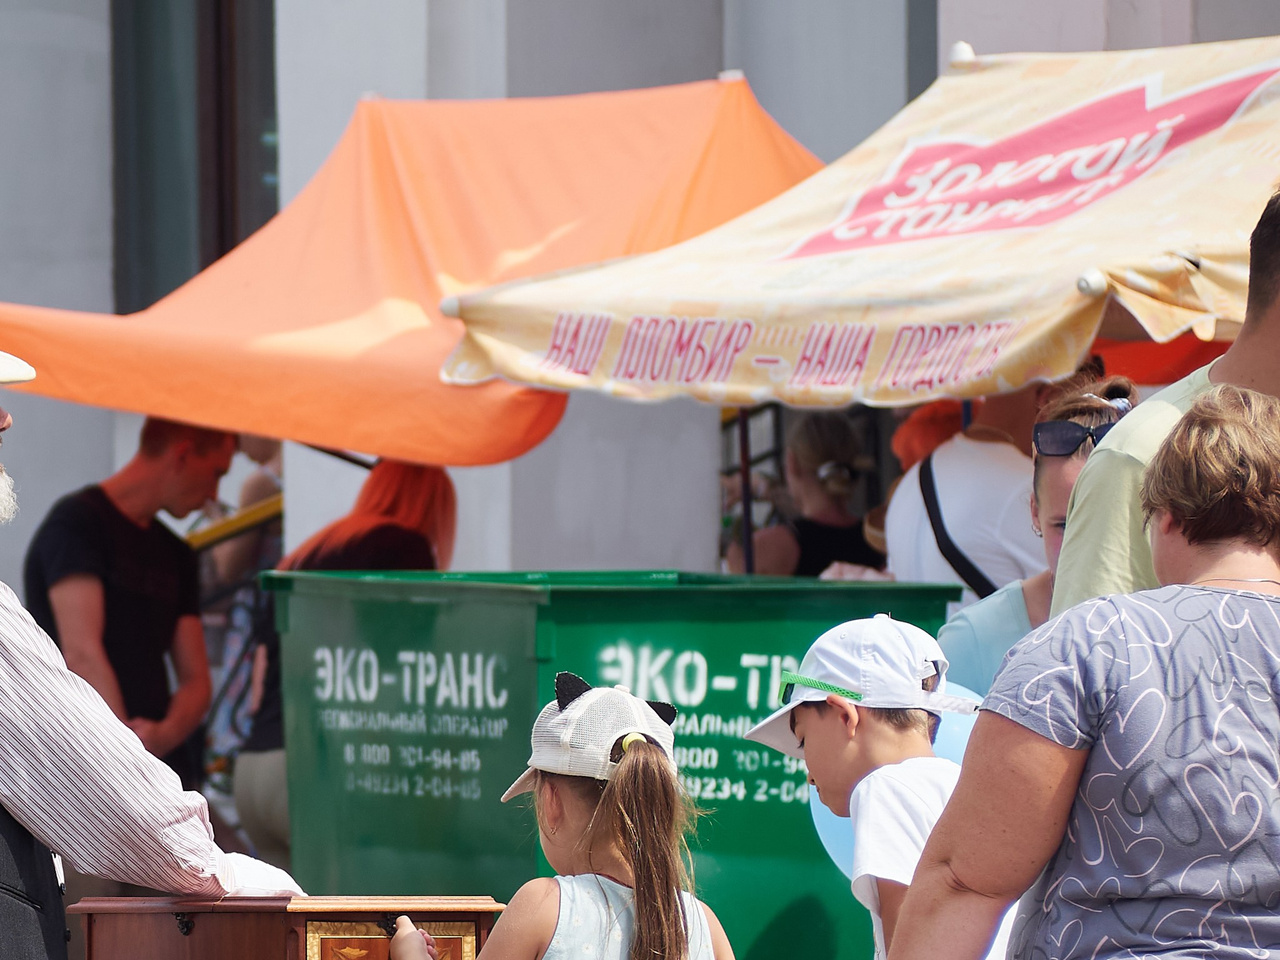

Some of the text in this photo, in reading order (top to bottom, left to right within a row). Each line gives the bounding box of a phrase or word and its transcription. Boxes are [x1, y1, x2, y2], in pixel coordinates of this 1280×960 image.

[546, 312, 613, 376] НАШ
[614, 316, 754, 383] ПЛОМБИР
[788, 323, 877, 387] НАША
[314, 647, 509, 709] ЭКО-ТРАНС
